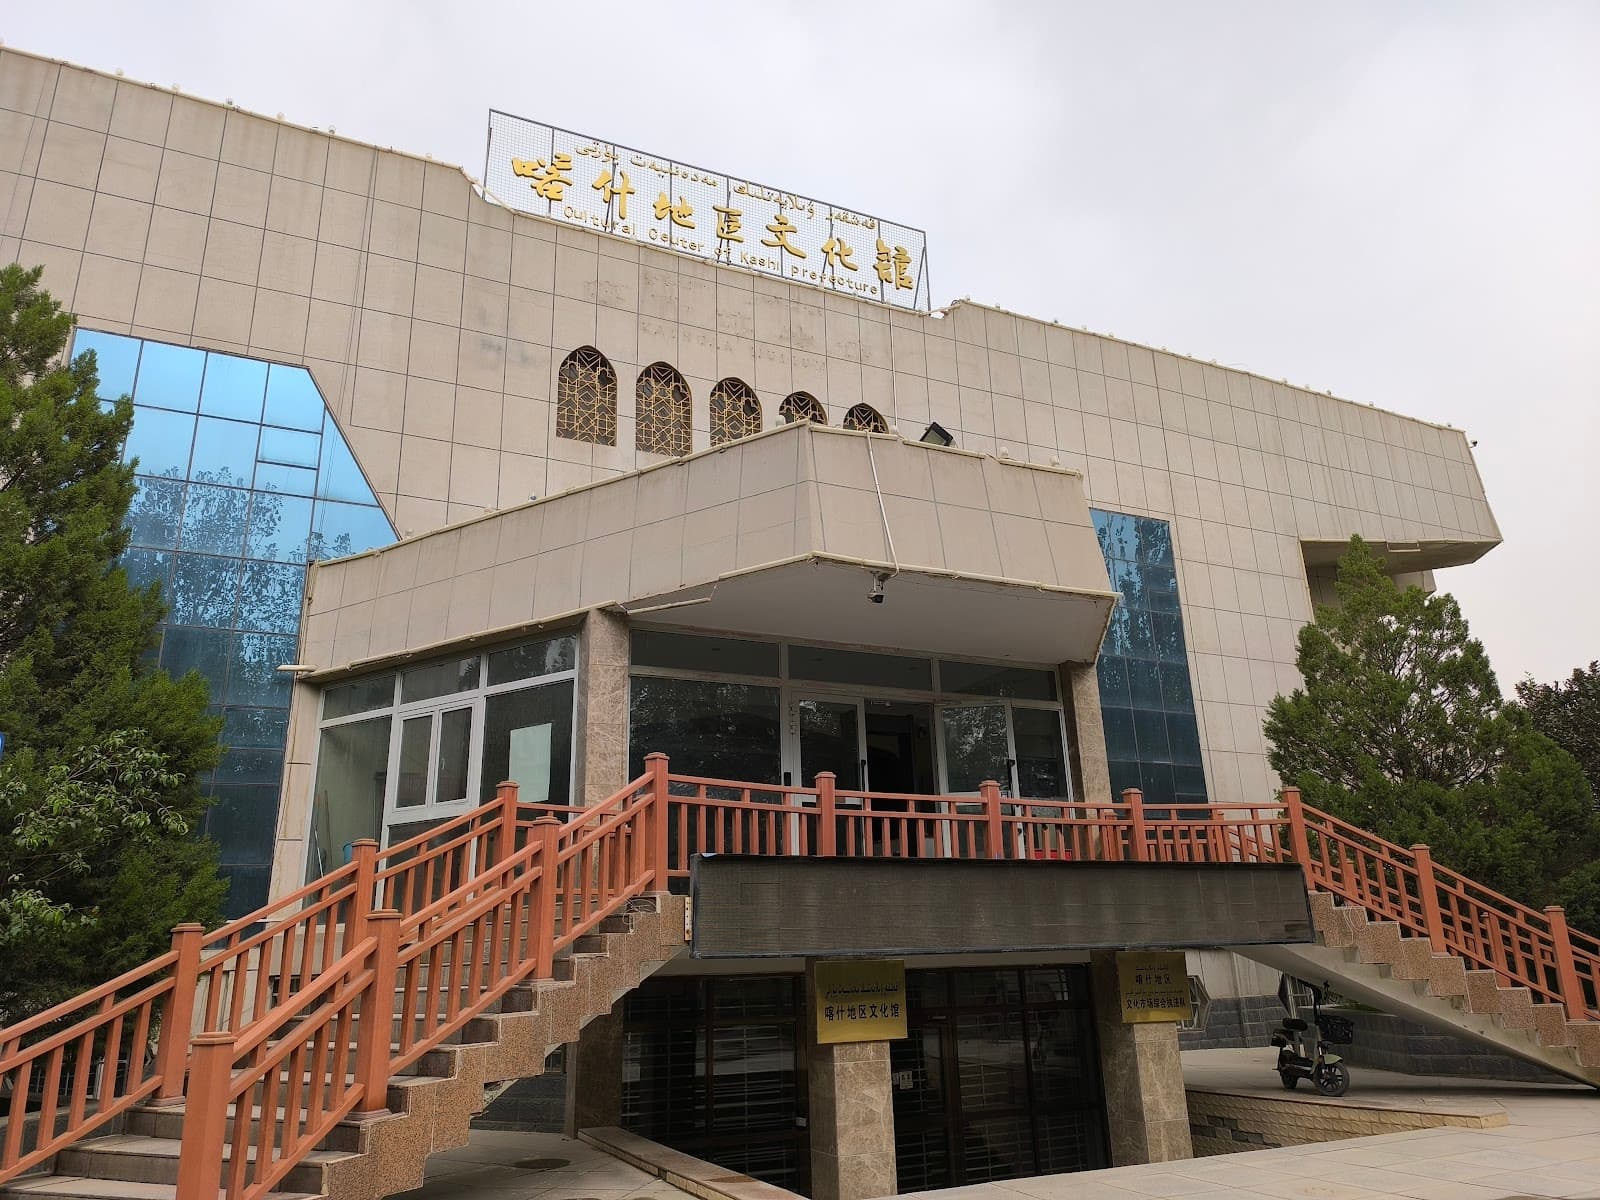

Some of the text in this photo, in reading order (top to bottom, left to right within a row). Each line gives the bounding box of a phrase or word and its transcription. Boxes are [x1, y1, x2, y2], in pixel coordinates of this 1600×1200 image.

[563, 206, 637, 236] Cultural
[714, 245, 732, 260] of
[740, 251, 779, 271] Kashi
[824, 1002, 901, 1022] 喀什地区文化馆
